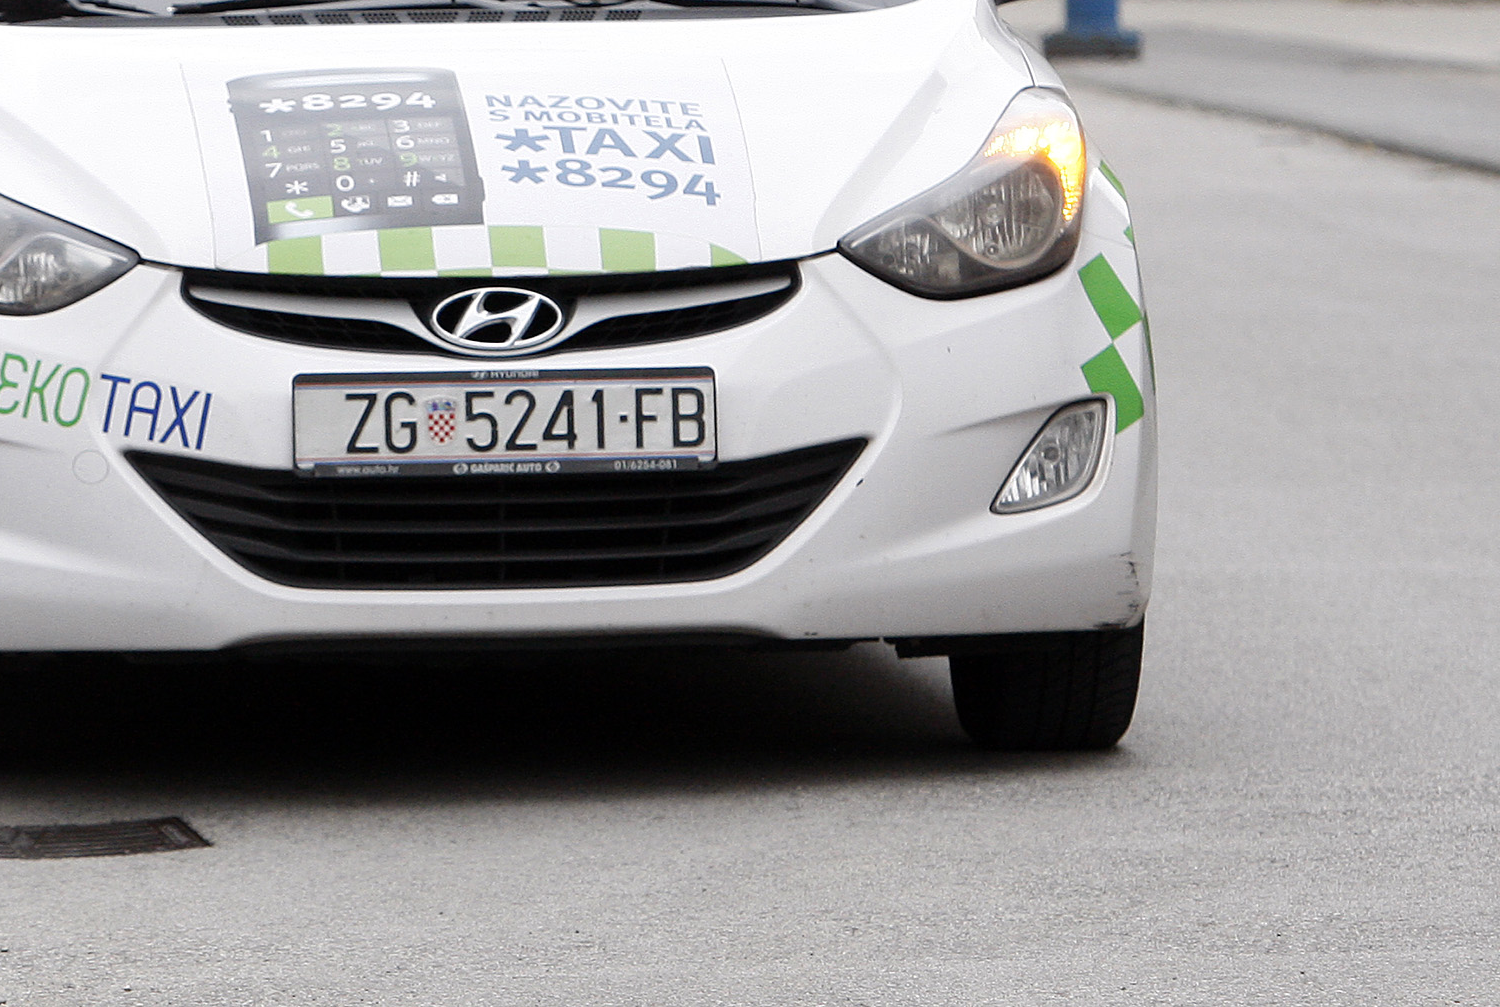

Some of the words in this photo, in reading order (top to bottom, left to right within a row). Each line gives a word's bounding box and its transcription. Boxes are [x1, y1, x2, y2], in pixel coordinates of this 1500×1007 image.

[485, 94, 703, 118] NAZOVITE
[260, 129, 272, 142] 1
[326, 123, 342, 136] 2
[392, 119, 410, 133] 3
[489, 109, 510, 122] S
[524, 110, 708, 132] MOBITELA
[262, 145, 280, 159] 4
[330, 138, 347, 153] 5
[396, 135, 414, 149] 6
[265, 162, 282, 178] 7
[333, 157, 351, 171] 8
[400, 152, 418, 167] 9
[345, 391, 418, 454] ZG
[516, 461, 542, 473] AUTO
